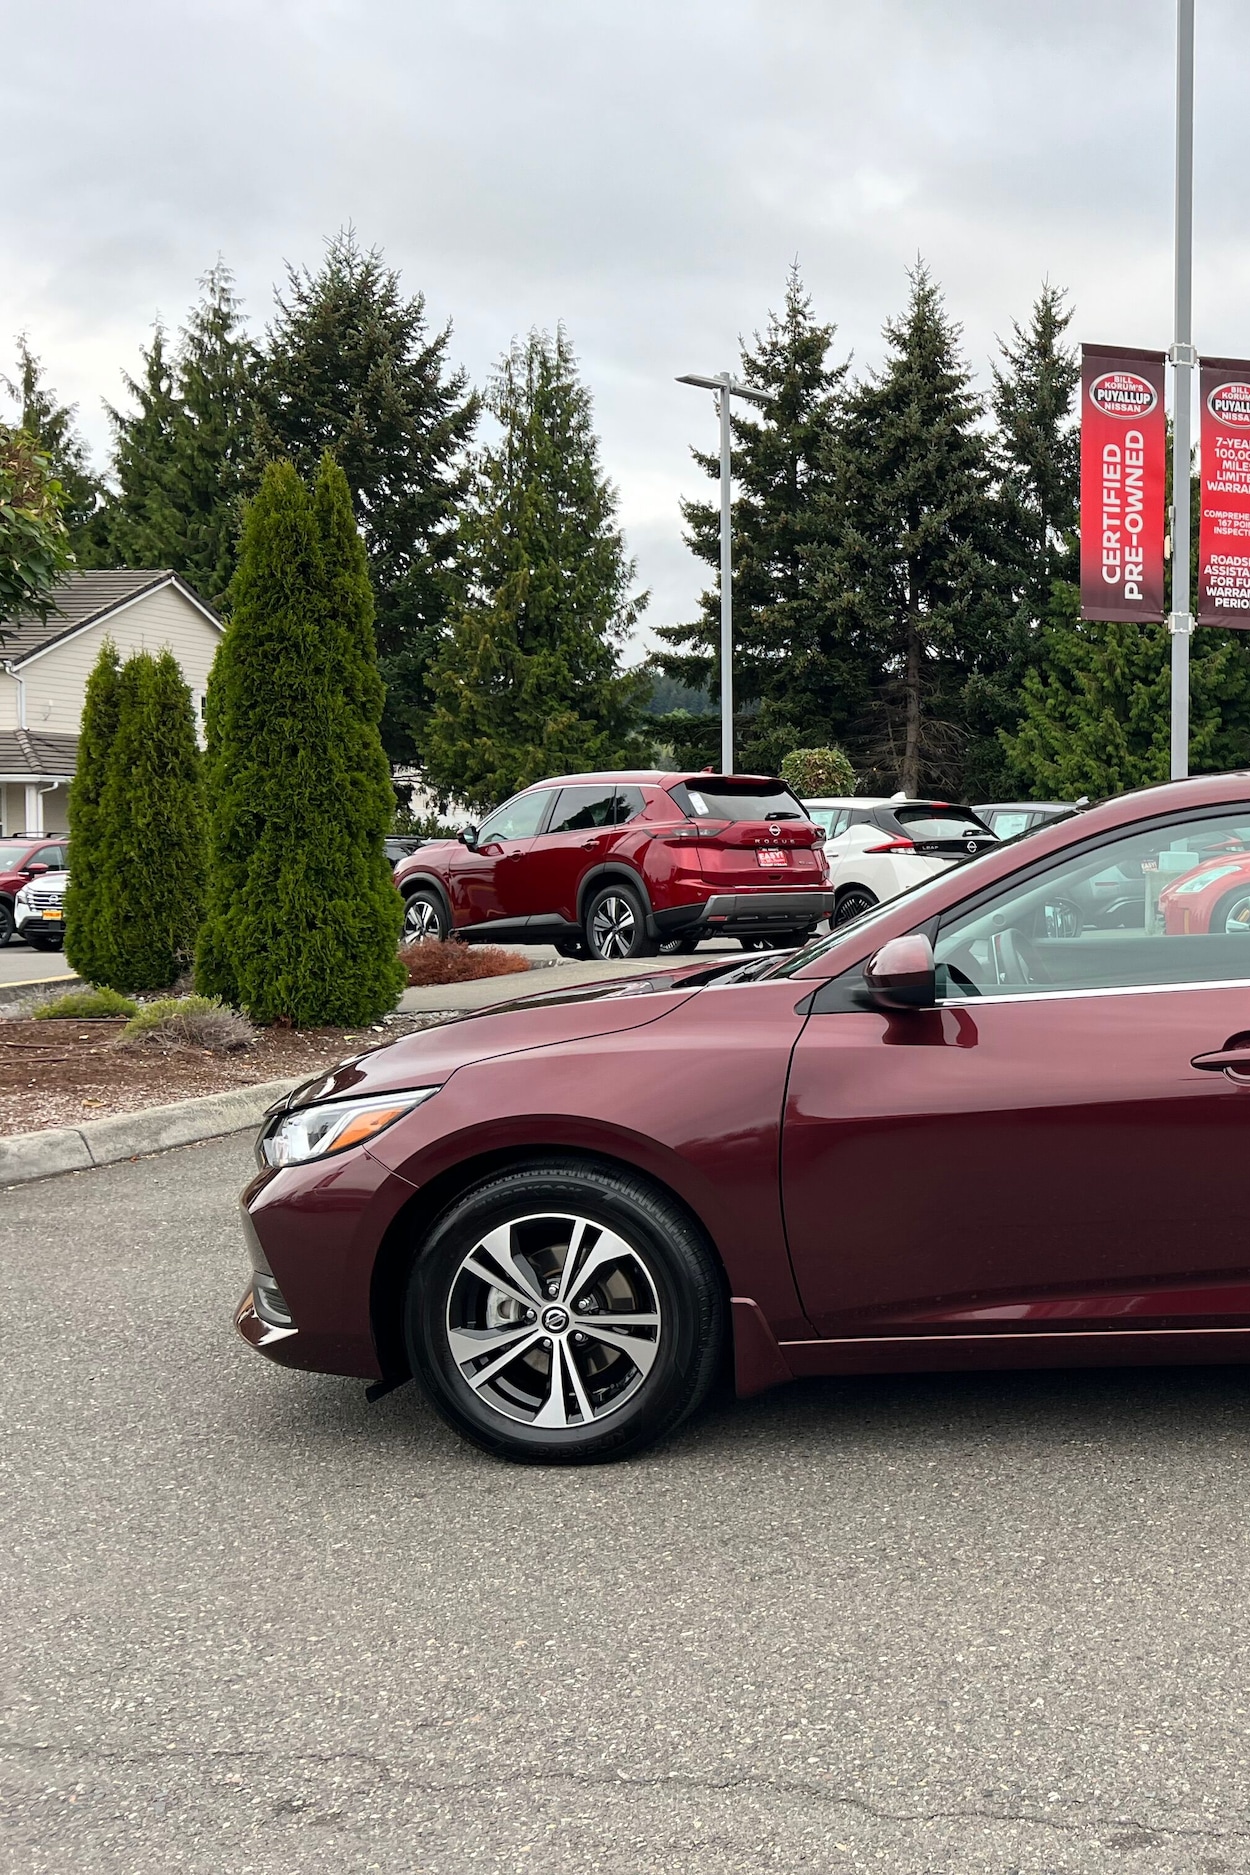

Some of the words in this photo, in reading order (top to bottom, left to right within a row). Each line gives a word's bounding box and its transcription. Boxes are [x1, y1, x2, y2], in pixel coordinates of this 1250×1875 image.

[1114, 375, 1133, 384] BILL
[1104, 381, 1143, 392] KORUM'S
[1231, 386, 1249, 394] BILL
[1097, 389, 1151, 405] PUYALLUP
[1104, 402, 1141, 413] NISSAN
[1101, 443, 1121, 584] CERTIFIED
[1124, 430, 1144, 600] PRE-OWNED
[1218, 519, 1232, 527] 167
[1210, 575, 1234, 587] FOR
[758, 851, 785, 860] EASY!
